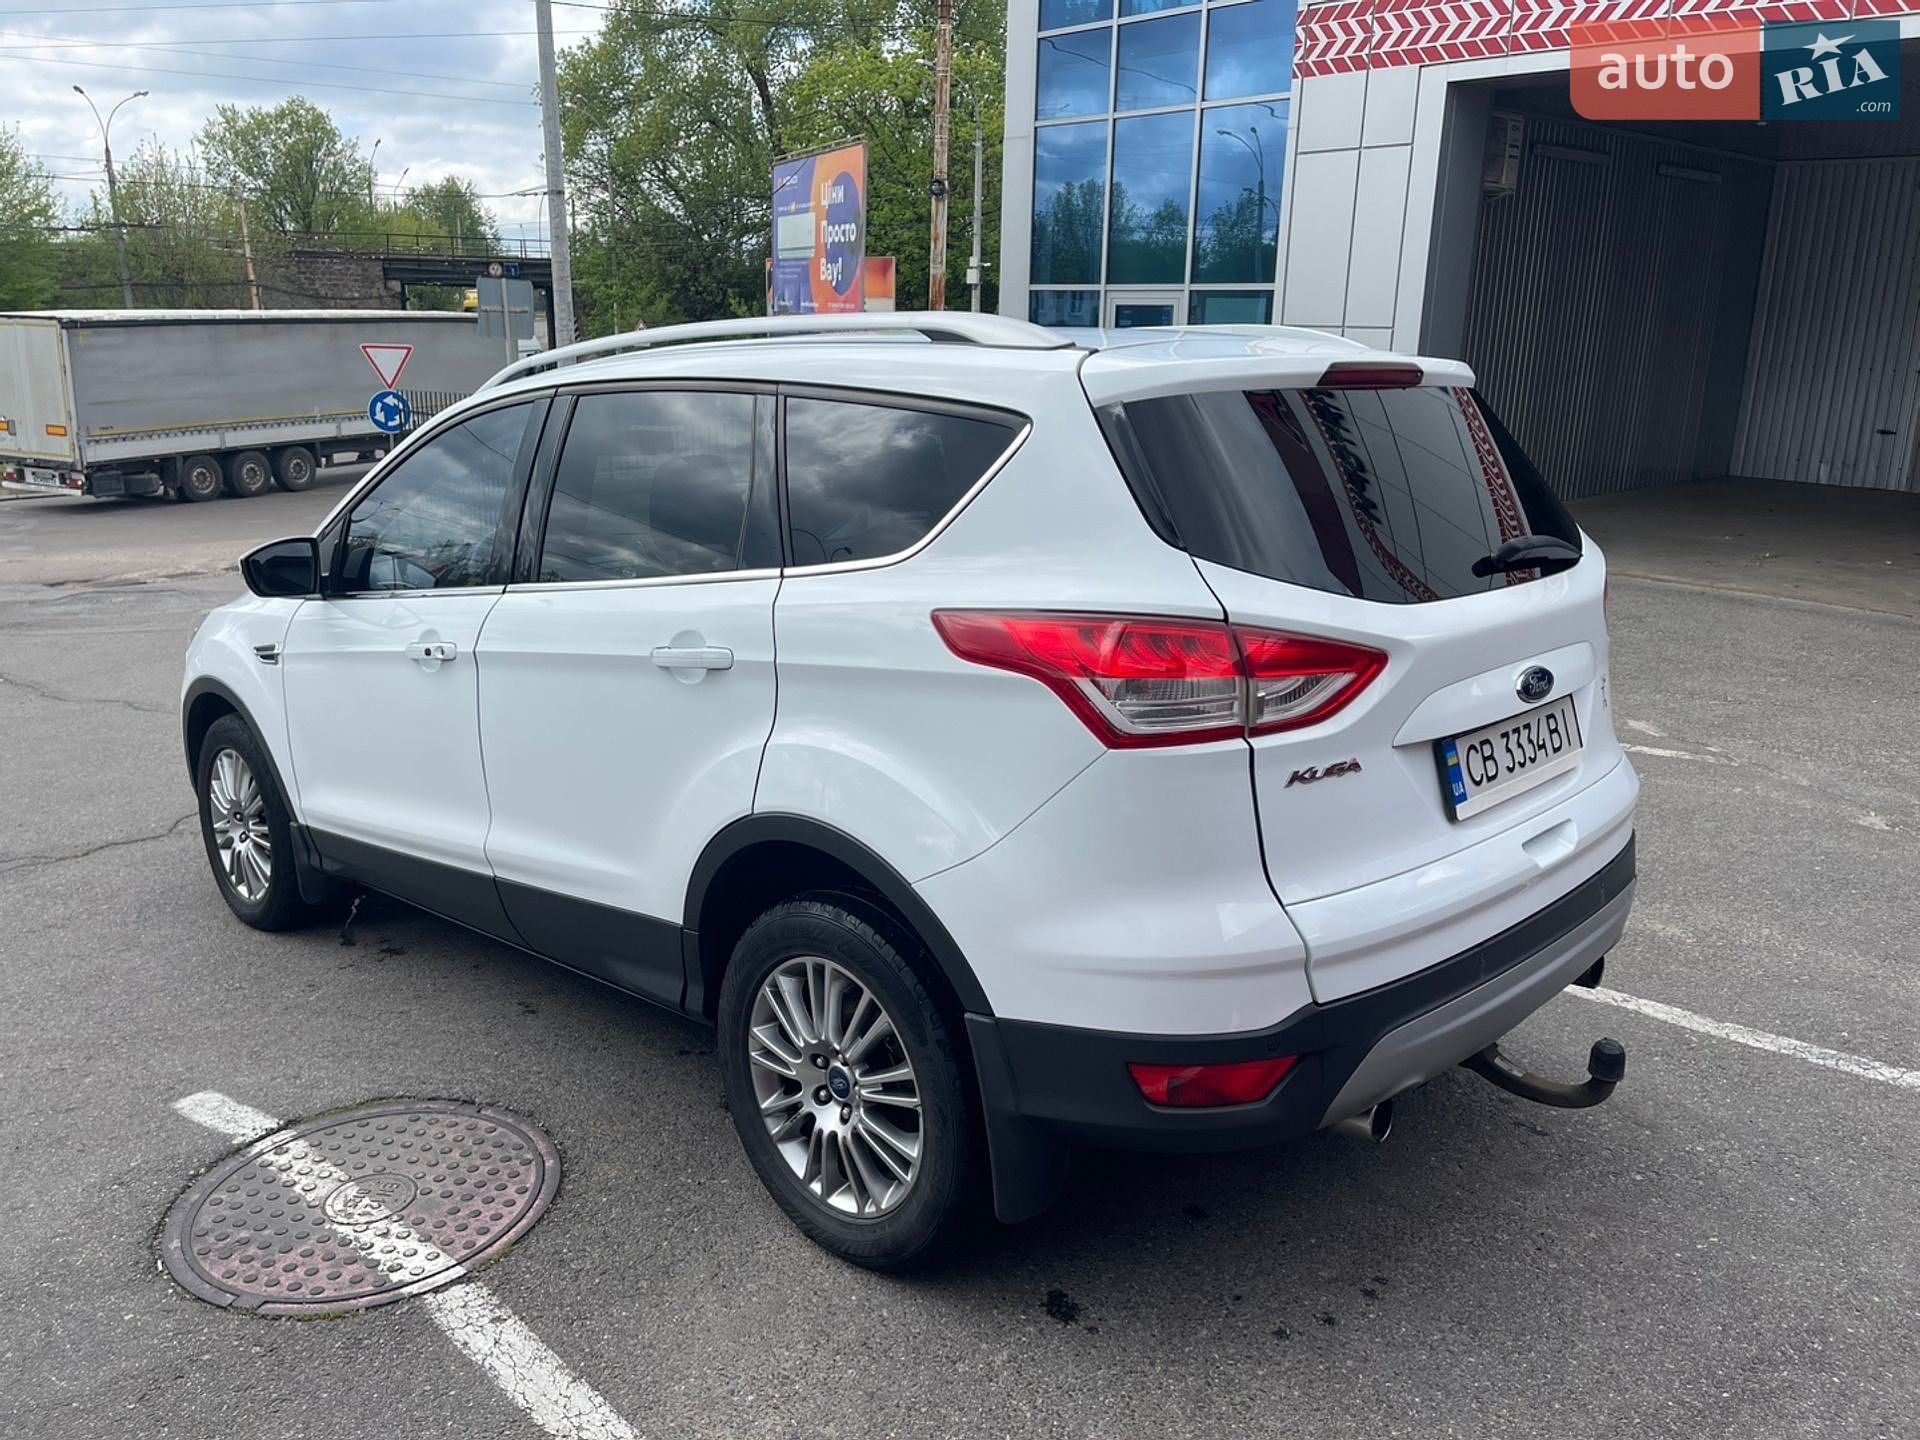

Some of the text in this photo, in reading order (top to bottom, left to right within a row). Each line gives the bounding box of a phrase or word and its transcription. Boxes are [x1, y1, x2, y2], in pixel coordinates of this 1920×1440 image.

[820, 179, 844, 209] Ціни
[821, 222, 857, 249] Просто
[820, 257, 842, 287] Вау!
[1528, 672, 1549, 697] Ford
[1284, 757, 1363, 788] KUGA
[1451, 781, 1464, 796] UA
